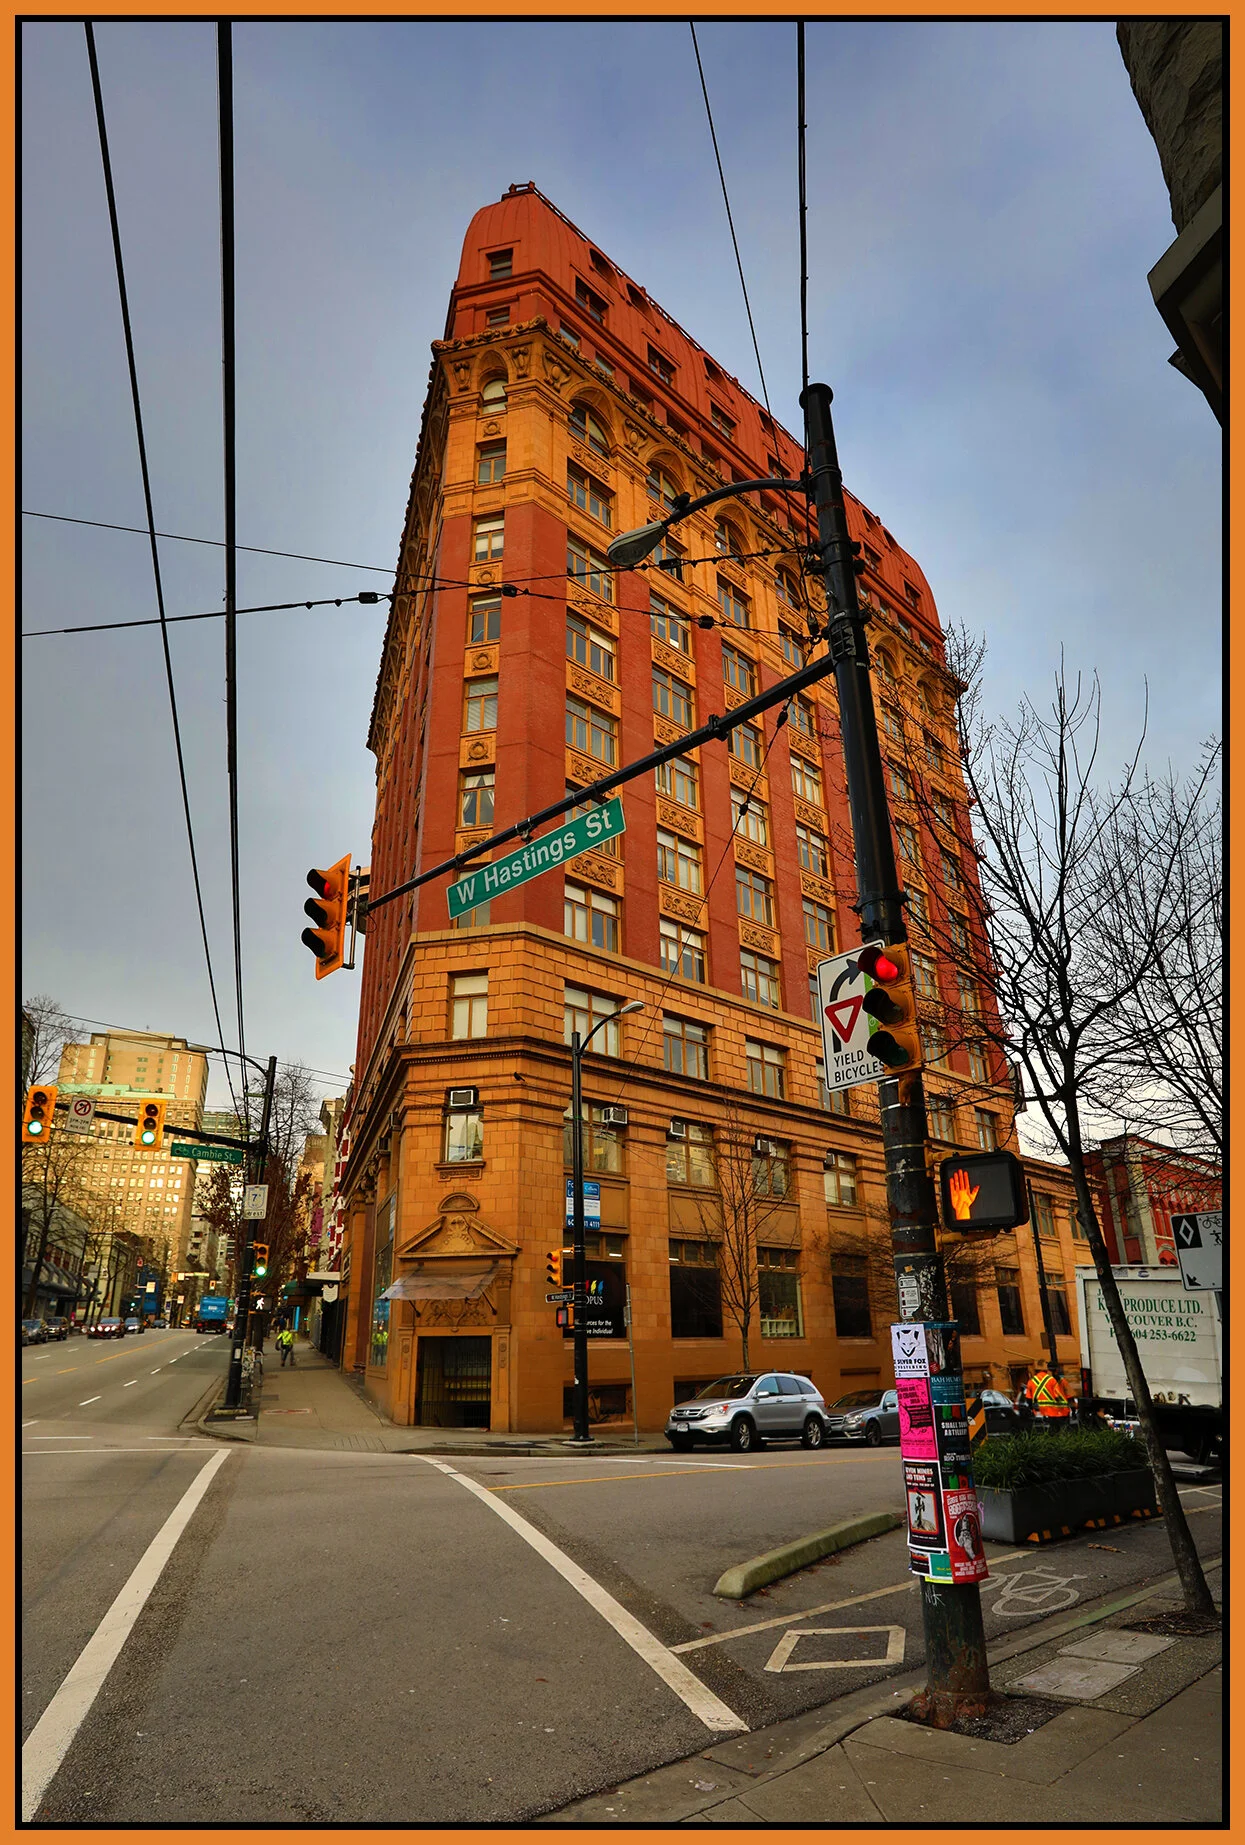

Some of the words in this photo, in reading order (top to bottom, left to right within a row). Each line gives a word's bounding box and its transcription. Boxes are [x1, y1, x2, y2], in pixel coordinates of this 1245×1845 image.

[457, 878, 475, 904] W
[484, 831, 576, 892] Hastings
[585, 808, 612, 838] St
[834, 1049, 864, 1067] YIELD
[192, 1148, 223, 1160] Cambie
[1124, 1298, 1176, 1314] PRODUCE
[1178, 1300, 1204, 1314] LTD.
[1105, 1314, 1175, 1328] VCOUVER
[1176, 1316, 1198, 1328] B.C.
[1150, 1329, 1196, 1342] 253-6622
